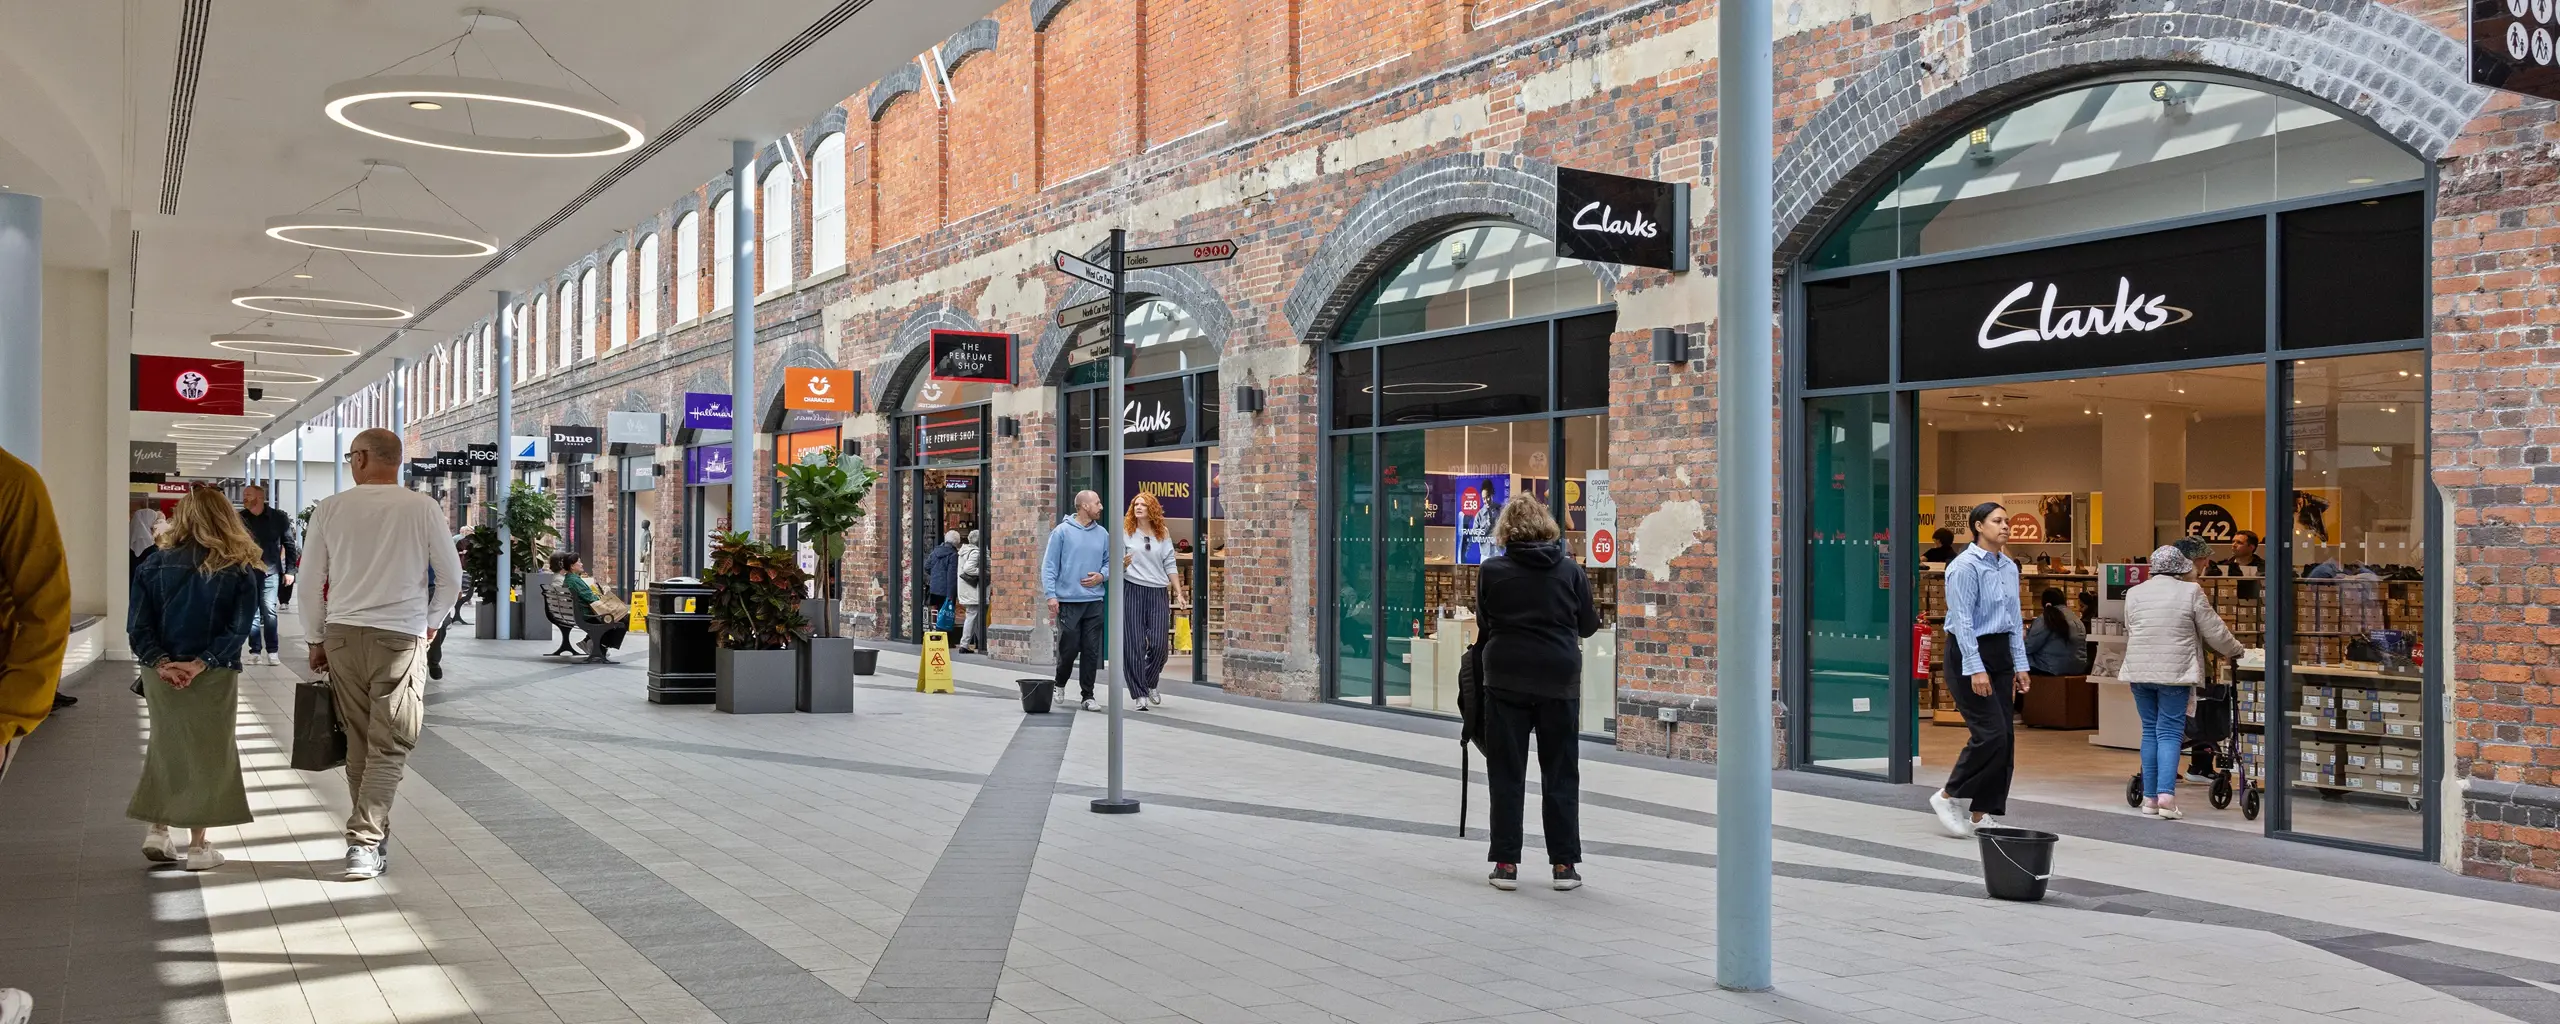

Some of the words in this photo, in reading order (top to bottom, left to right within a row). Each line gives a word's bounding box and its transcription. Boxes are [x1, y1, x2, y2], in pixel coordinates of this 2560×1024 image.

[1572, 201, 1658, 238] Clarks
[1126, 256, 1148, 266] Toilets
[1085, 266, 1096, 279] West
[1096, 271, 1104, 281] Car
[1104, 274, 1112, 286] Park
[1082, 307, 1093, 318] North
[1978, 276, 2168, 349] Clarks
[962, 342, 979, 351] THE
[949, 351, 992, 361] PERFUME
[958, 361, 984, 370] SHOP
[1124, 400, 1171, 434] Clarks
[554, 433, 593, 443] Dune
[922, 436, 932, 445] THE
[934, 432, 957, 443] PERFUME
[959, 430, 975, 440] SHOP
[134, 448, 163, 464] Yumi
[1138, 481, 1190, 498] WOMENS
[1463, 500, 1478, 510] £38
[1945, 505, 1950, 513] IT
[2009, 524, 2038, 539] £22
[2186, 521, 2231, 540] £42
[1595, 542, 1611, 553] £19
